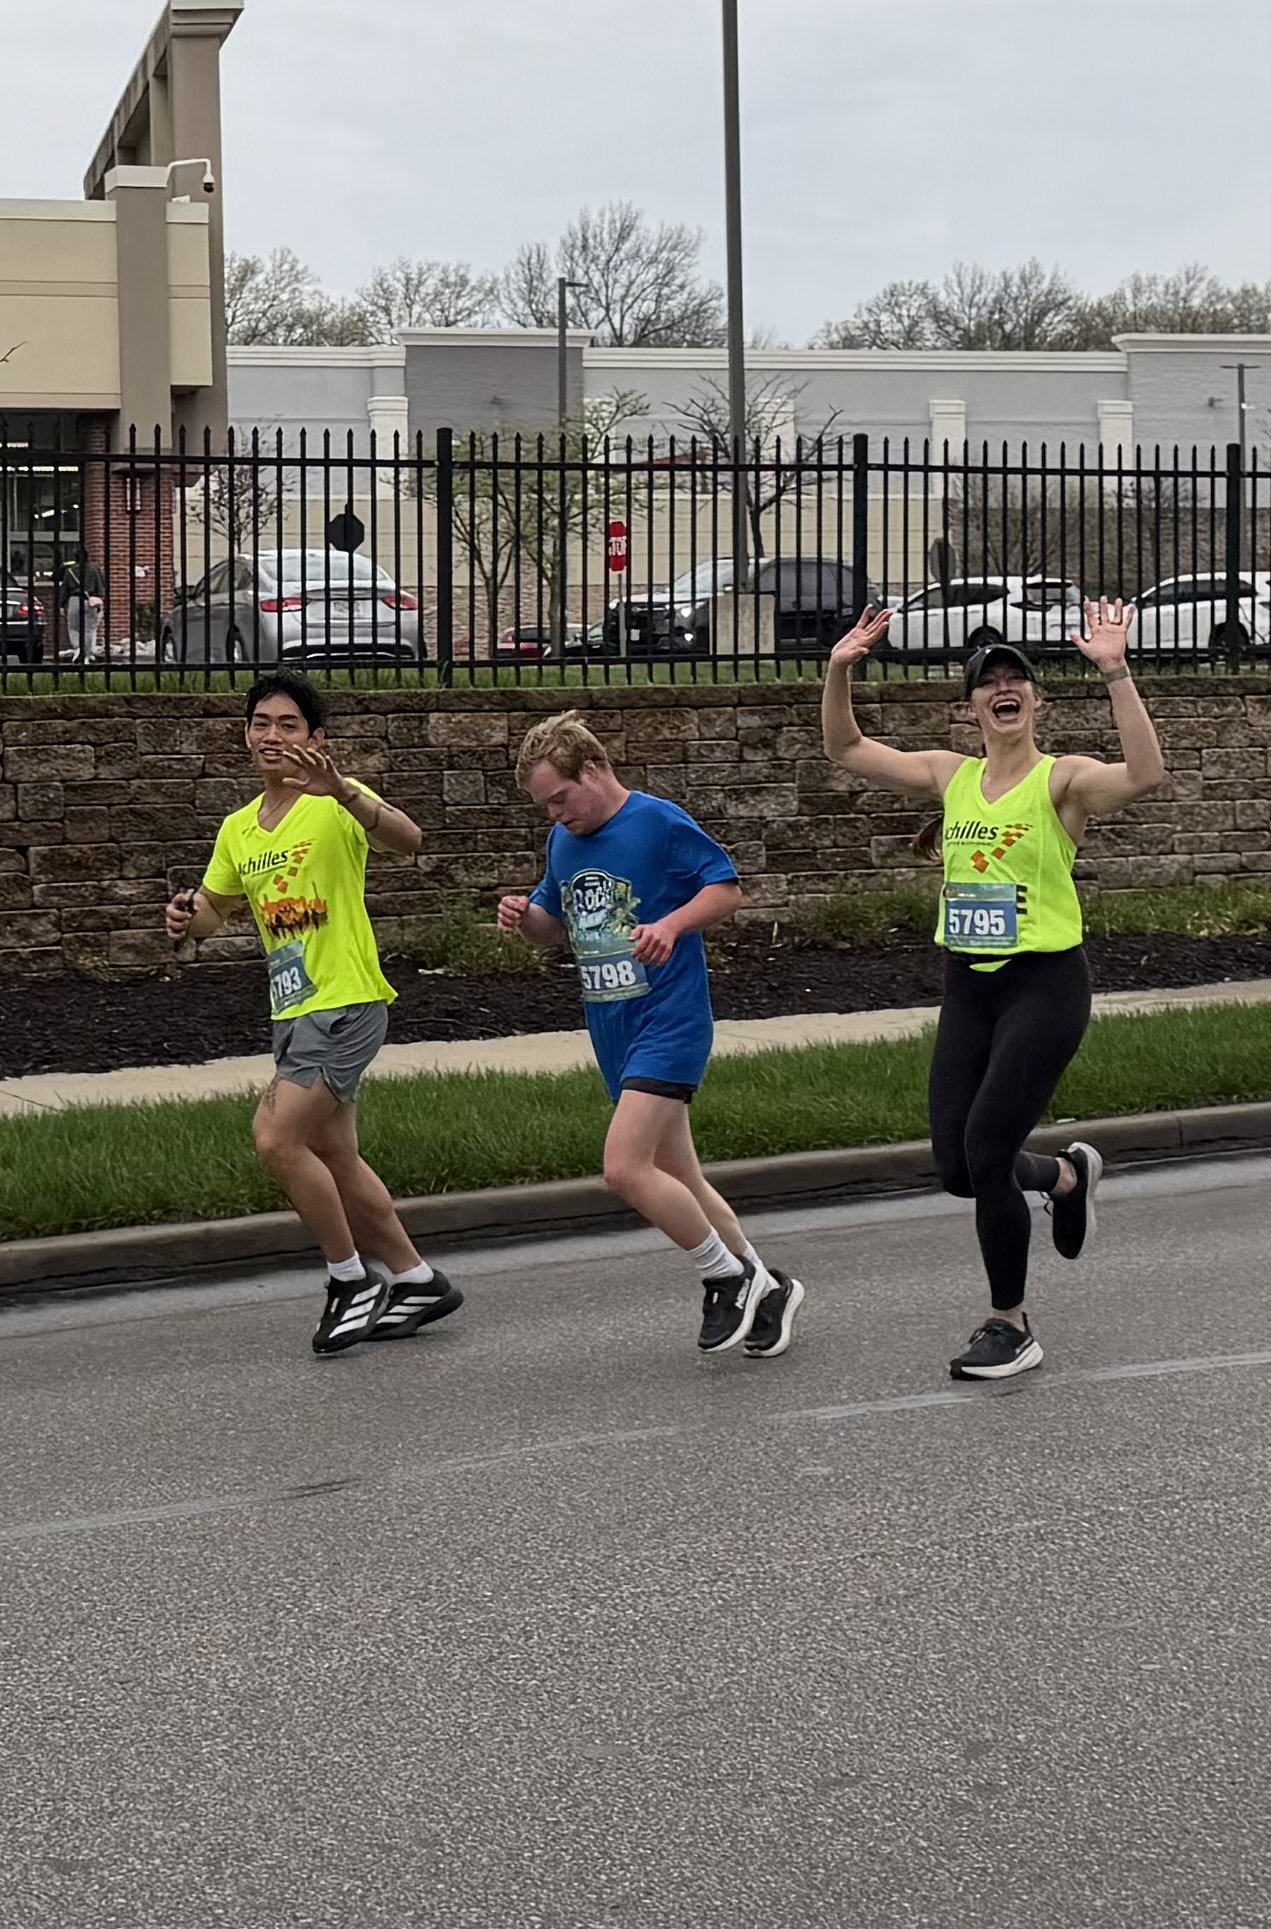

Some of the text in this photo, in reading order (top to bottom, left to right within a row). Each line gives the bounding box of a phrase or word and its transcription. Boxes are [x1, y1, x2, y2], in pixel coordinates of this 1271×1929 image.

[945, 820, 999, 840] chilles
[948, 908, 1006, 936] 5795
[580, 960, 637, 990] 5798
